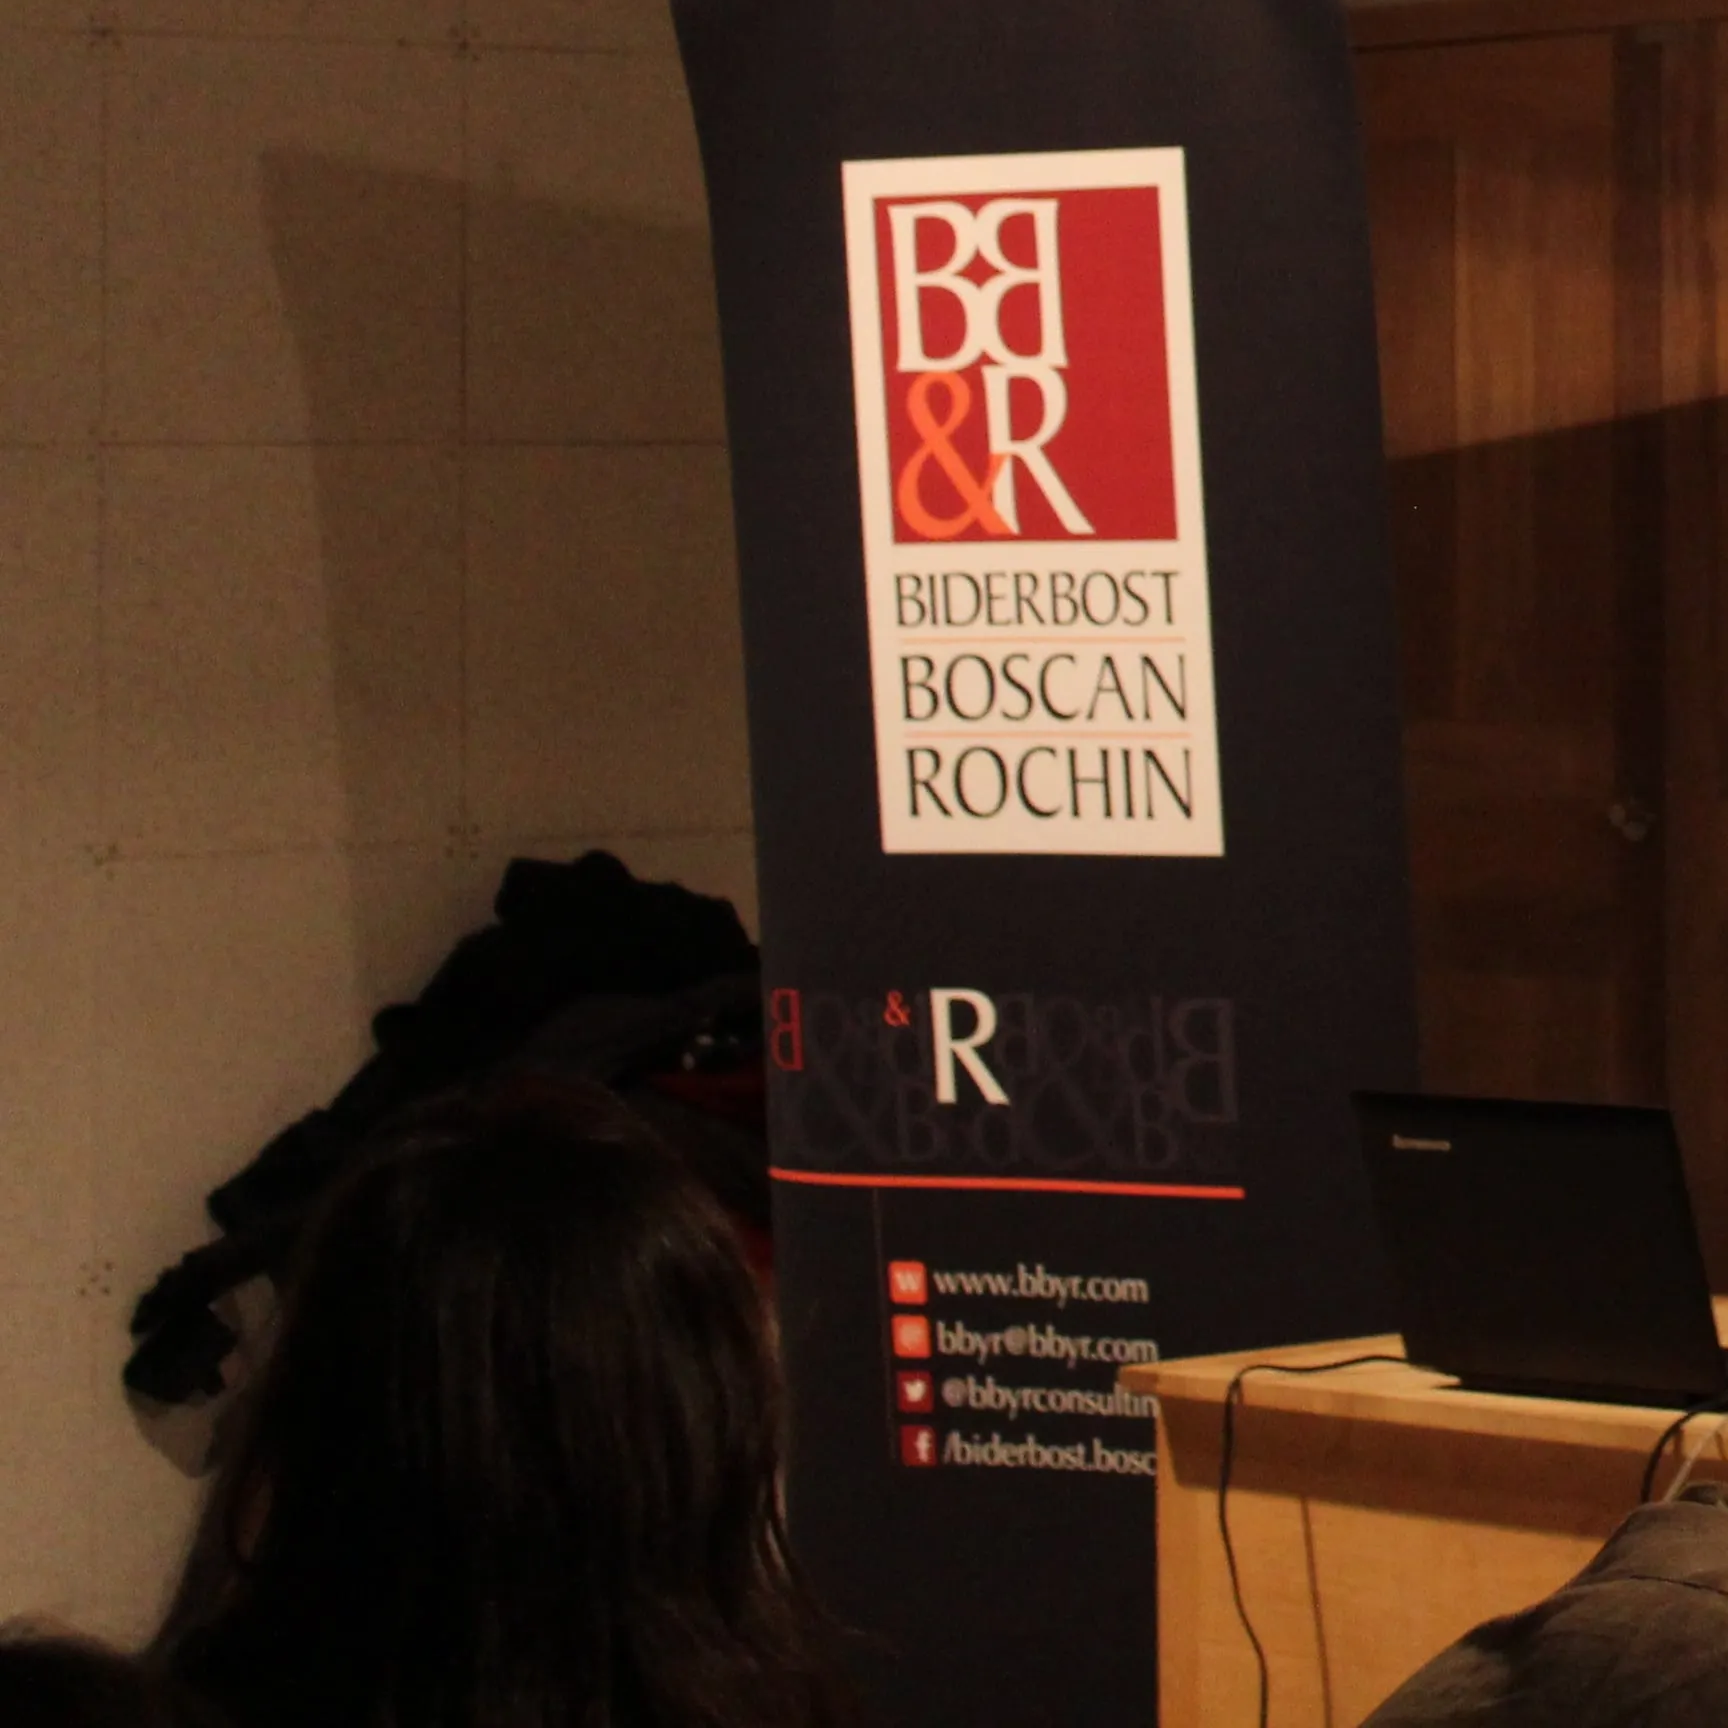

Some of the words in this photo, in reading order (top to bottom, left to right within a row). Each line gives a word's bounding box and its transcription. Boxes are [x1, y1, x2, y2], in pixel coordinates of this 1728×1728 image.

[892, 568, 1181, 630] BIDERBOST
[898, 651, 1189, 725] BOSCAN
[903, 744, 1194, 821] ROCHIN
[928, 986, 1011, 1106] R
[932, 1261, 1151, 1311] www.bbyr.com
[936, 1319, 1160, 1371] bbyr@bbyr.com
